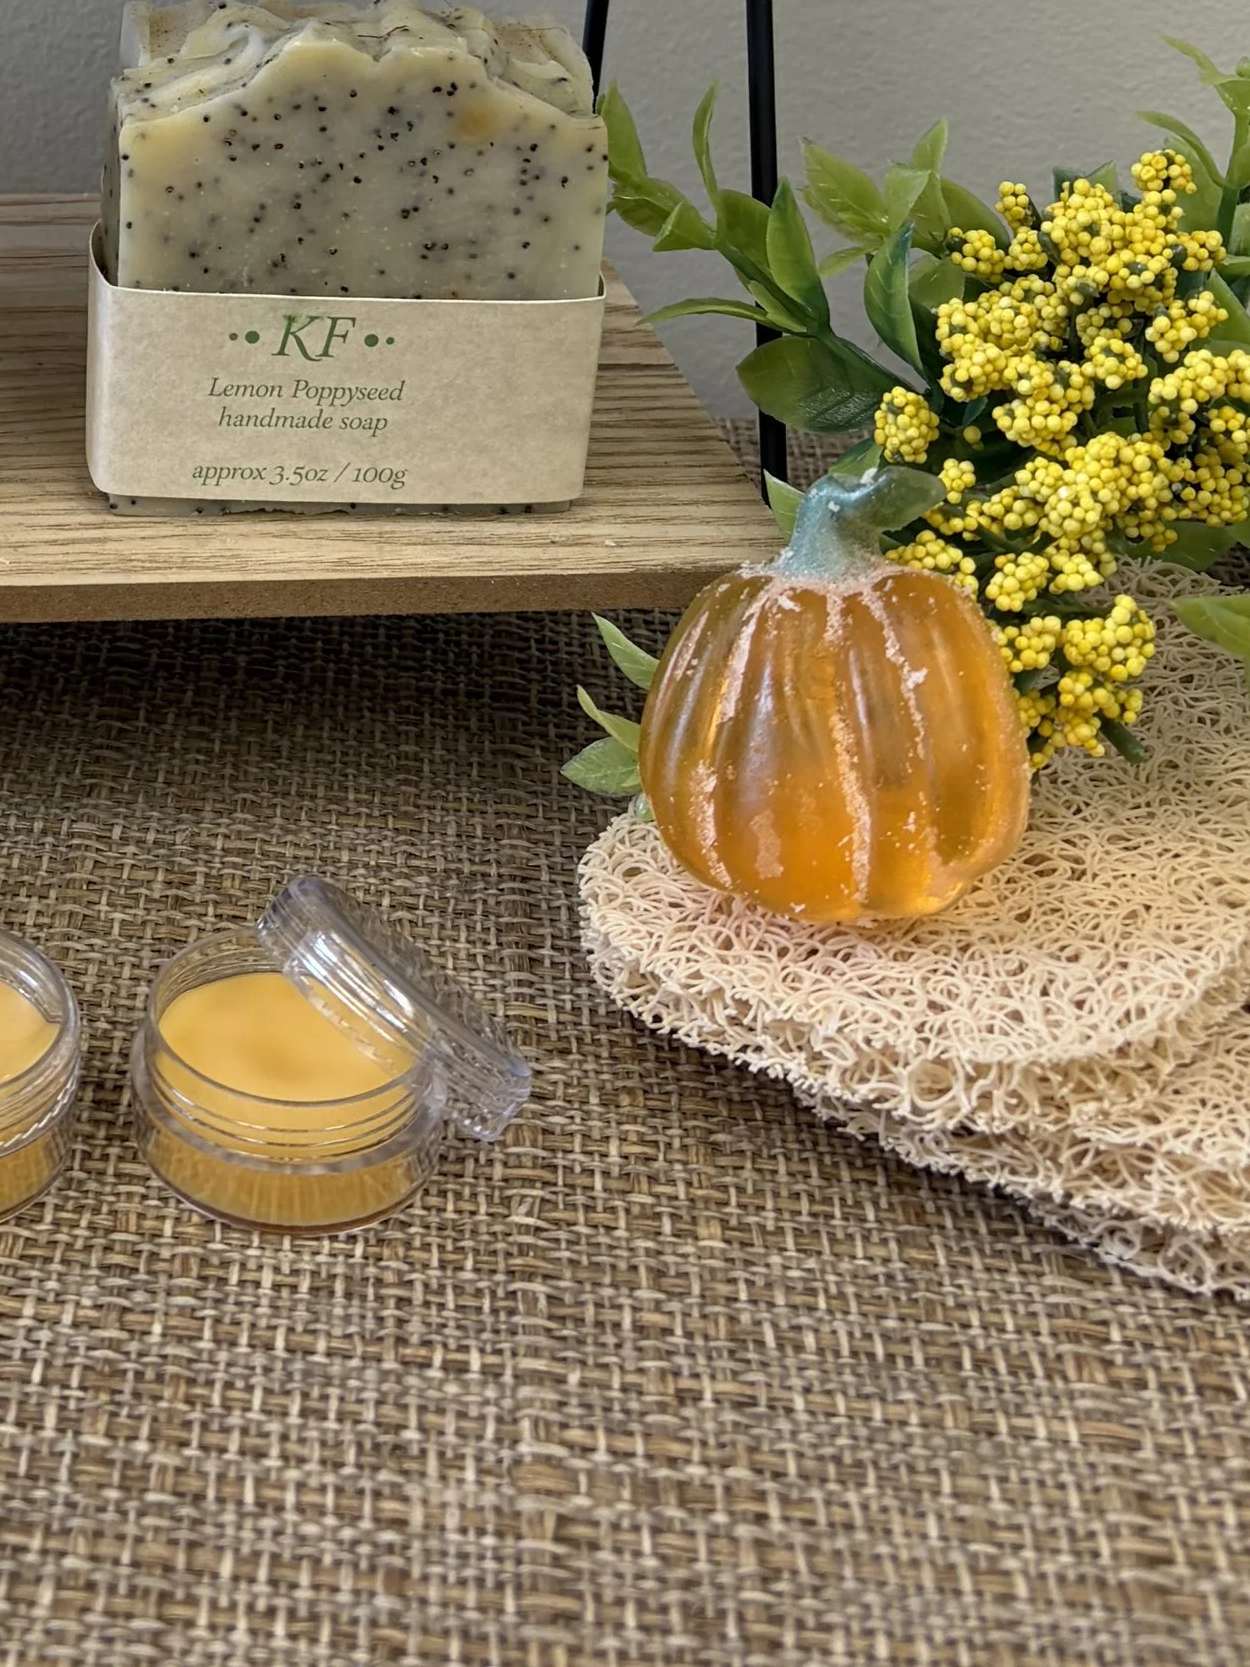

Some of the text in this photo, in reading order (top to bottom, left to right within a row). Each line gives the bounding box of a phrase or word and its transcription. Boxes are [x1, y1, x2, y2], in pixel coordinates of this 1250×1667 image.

[271, 314, 356, 362] KF
[208, 378, 405, 406] Lemon Poppyseed
[218, 407, 388, 437] handmade soap
[192, 465, 266, 486] approx
[269, 466, 328, 485] 3.5oz
[352, 467, 408, 490] 100g
